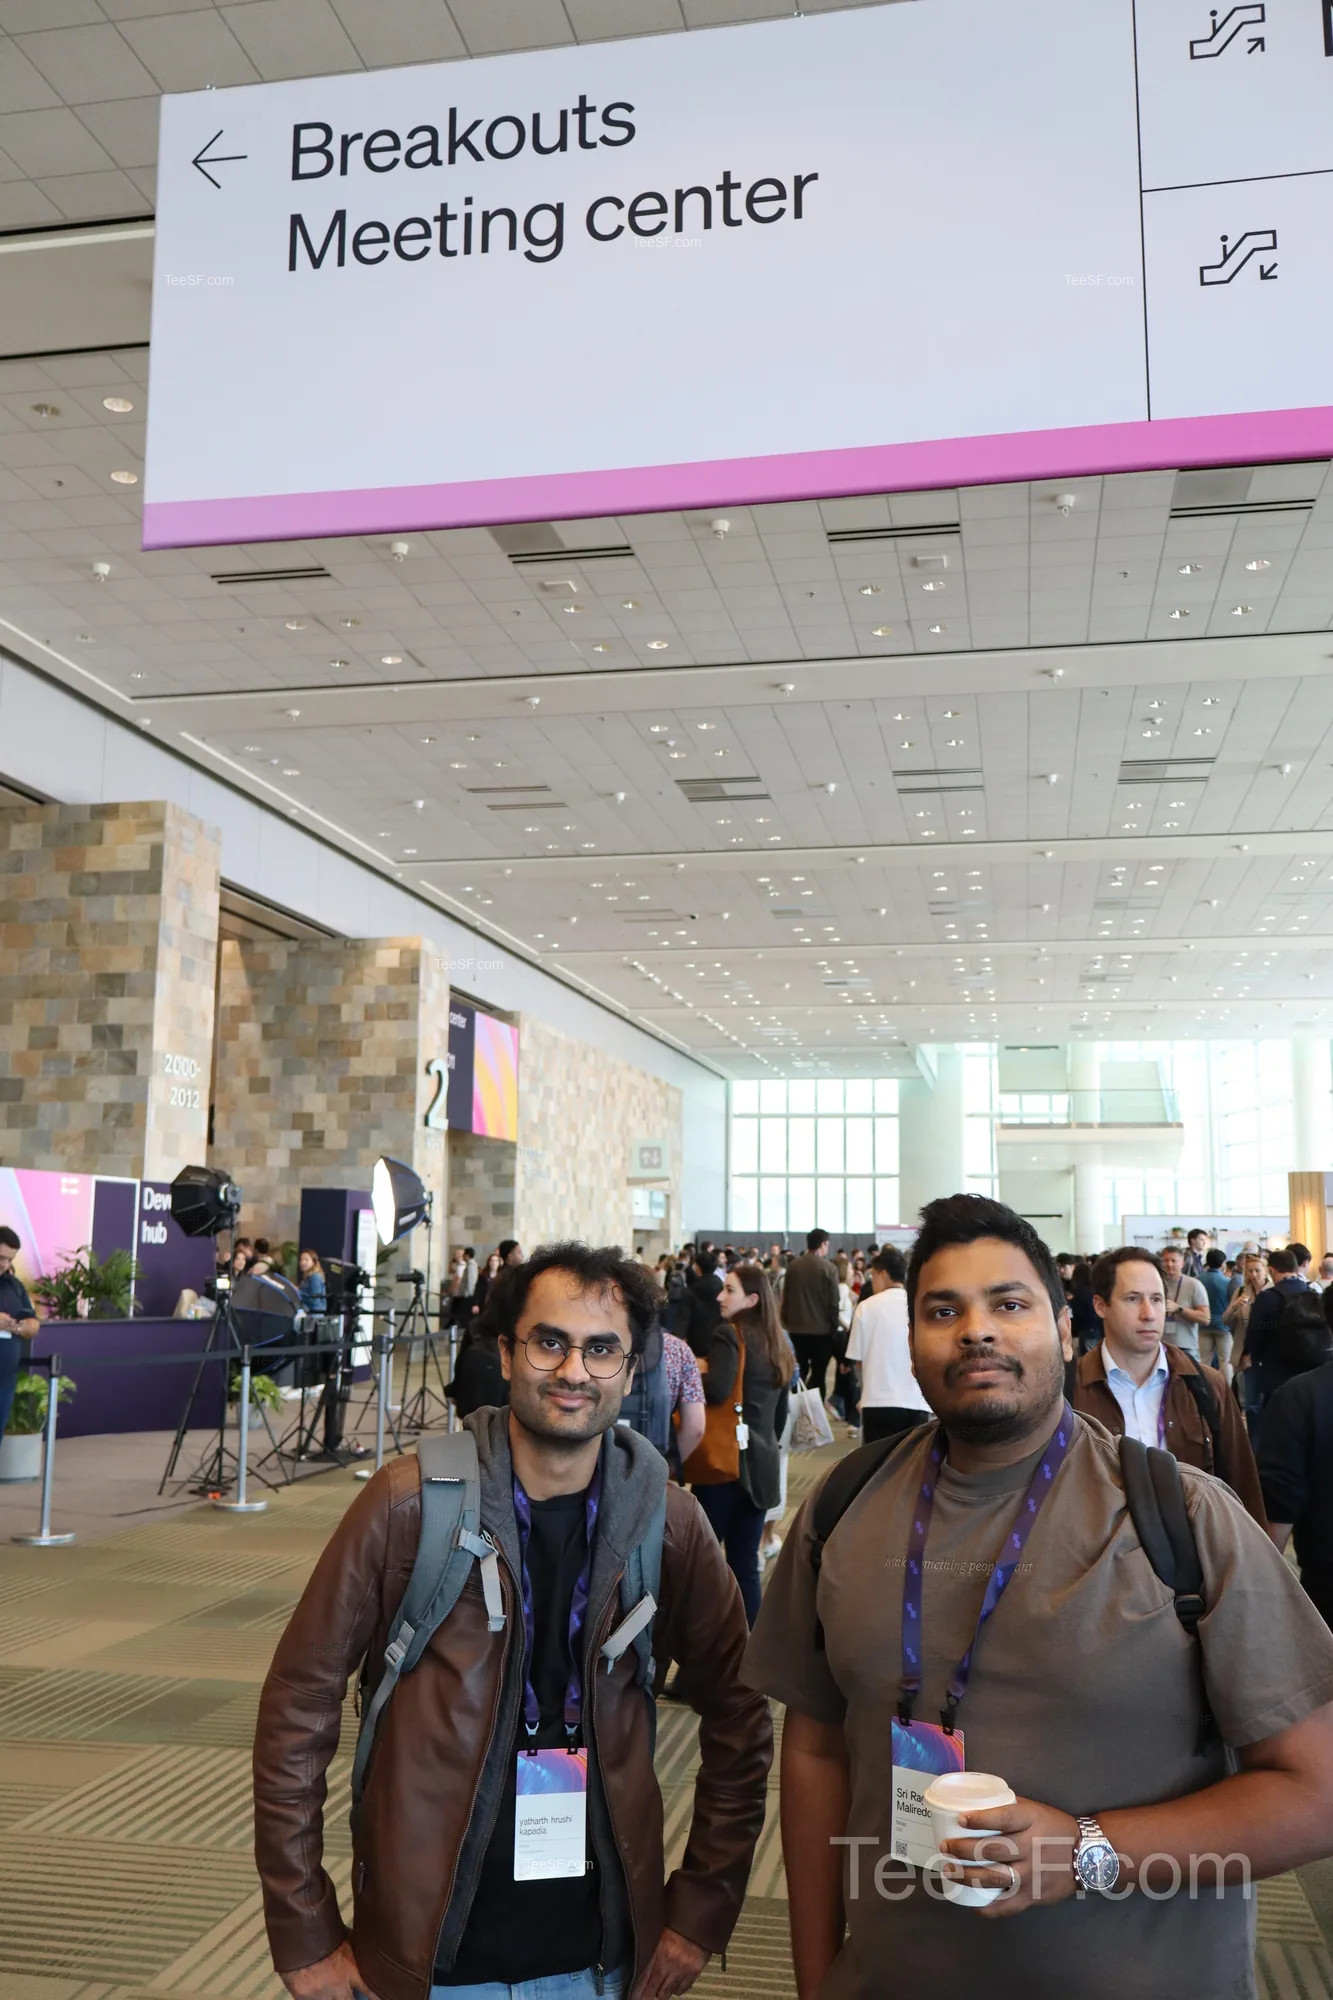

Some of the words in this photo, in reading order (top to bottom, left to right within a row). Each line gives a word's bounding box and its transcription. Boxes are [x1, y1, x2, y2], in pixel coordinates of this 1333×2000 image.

[291, 94, 636, 181] Breakouts
[288, 196, 565, 272] Meeting
[585, 170, 819, 242] center
[164, 1053, 202, 1078] 2000-
[169, 1086, 200, 1109] 2012
[424, 1057, 449, 1131] 2
[143, 1187, 172, 1211] Dev
[141, 1219, 168, 1244] hub
[885, 1555, 907, 1568] Mak
[922, 1558, 967, 1575] mething
[968, 1560, 996, 1577] peop
[1014, 1562, 1033, 1573] ant
[896, 1787, 908, 1799] Sri
[519, 1817, 549, 1828] yatharth
[519, 1826, 547, 1837] kapadia
